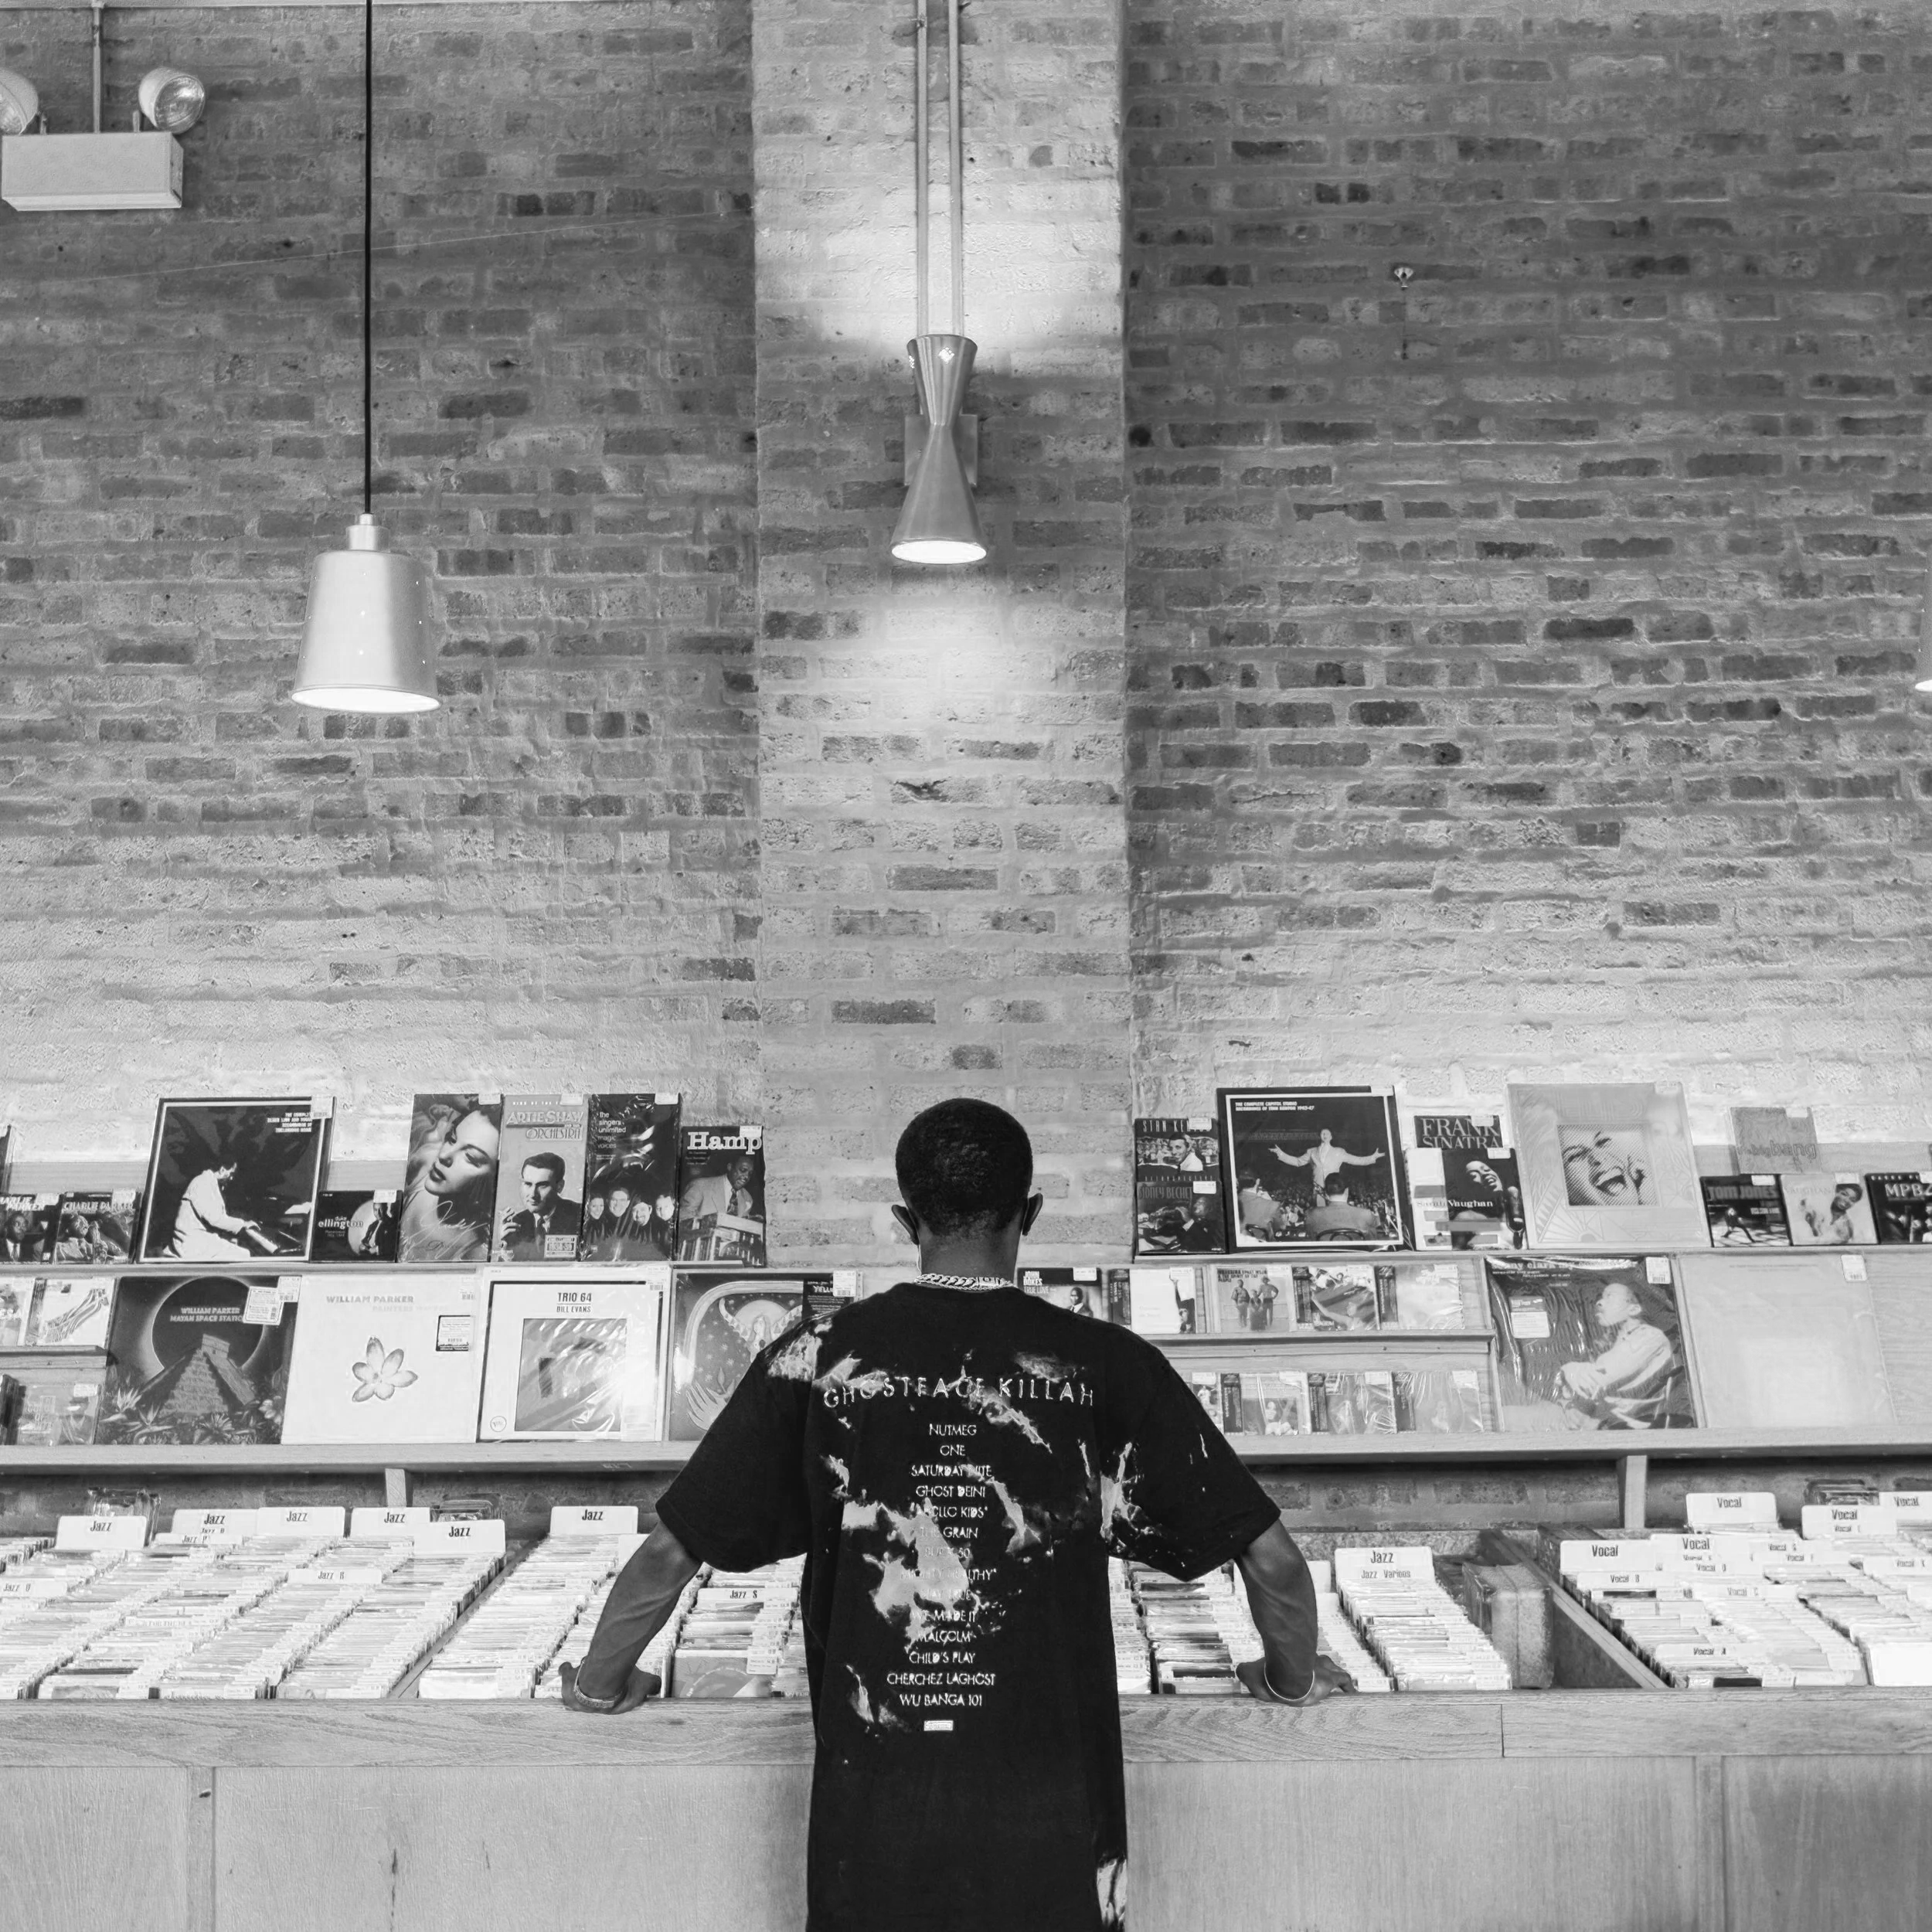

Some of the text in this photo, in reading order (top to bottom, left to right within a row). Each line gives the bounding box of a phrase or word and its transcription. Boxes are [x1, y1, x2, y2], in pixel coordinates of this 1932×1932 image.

[506, 1111, 583, 1124] ARTIE SHAW
[1421, 1117, 1500, 1137] FRANK
[597, 1134, 617, 1143] magic
[687, 1131, 762, 1155] Hamp
[1422, 1136, 1501, 1149] SINATRA
[1770, 1140, 1816, 1159] bang
[1708, 1185, 1777, 1199] TOM JONES
[64, 1202, 99, 1211] CHARLIE
[1448, 1199, 1494, 1209] Vaughan
[318, 1219, 364, 1230] ellington
[558, 1292, 592, 1302] TRIO 64
[999, 1378, 1094, 1406] KILLAH
[929, 1423, 977, 1436] NUTMEG
[940, 1444, 966, 1456] ONE
[911, 1464, 964, 1477] SATURDAY
[915, 1485, 986, 1498] GHOST DEINI
[1717, 1496, 1743, 1509] Vocal
[1894, 1496, 1920, 1507] Vocal
[287, 1511, 308, 1522] Jazz
[384, 1512, 406, 1523] Jazz
[582, 1509, 604, 1522] Jazz
[915, 1505, 957, 1518] OLLO
[1832, 1509, 1858, 1520] Vocal
[204, 1513, 226, 1526] Jazz
[90, 1520, 113, 1532] Jazz
[448, 1526, 471, 1538] Jazz
[943, 1526, 978, 1539] GRAIN
[182, 1535, 198, 1544] Jazz
[1682, 1537, 1710, 1550] Vocal
[1370, 1550, 1394, 1564] Jazz
[1591, 1545, 1619, 1557] Vocal
[1696, 1563, 1716, 1572] Vocal
[318, 1570, 335, 1580] Jazz
[1361, 1570, 1411, 1580] Jazz Various
[1610, 1574, 1630, 1583] Vocal
[3, 1583, 21, 1592] Jazz
[1726, 1587, 1748, 1597] Vocal
[730, 1589, 747, 1599] Jazz
[933, 1609, 967, 1622] MADE
[968, 1610, 977, 1623] IT
[1692, 1647, 1715, 1656] Vocal
[909, 1651, 976, 1665] CHILD'S PLAY
[886, 1672, 996, 1685] CHERCHEZ LAGHOST
[900, 1692, 982, 1706] WU BANGA 101
